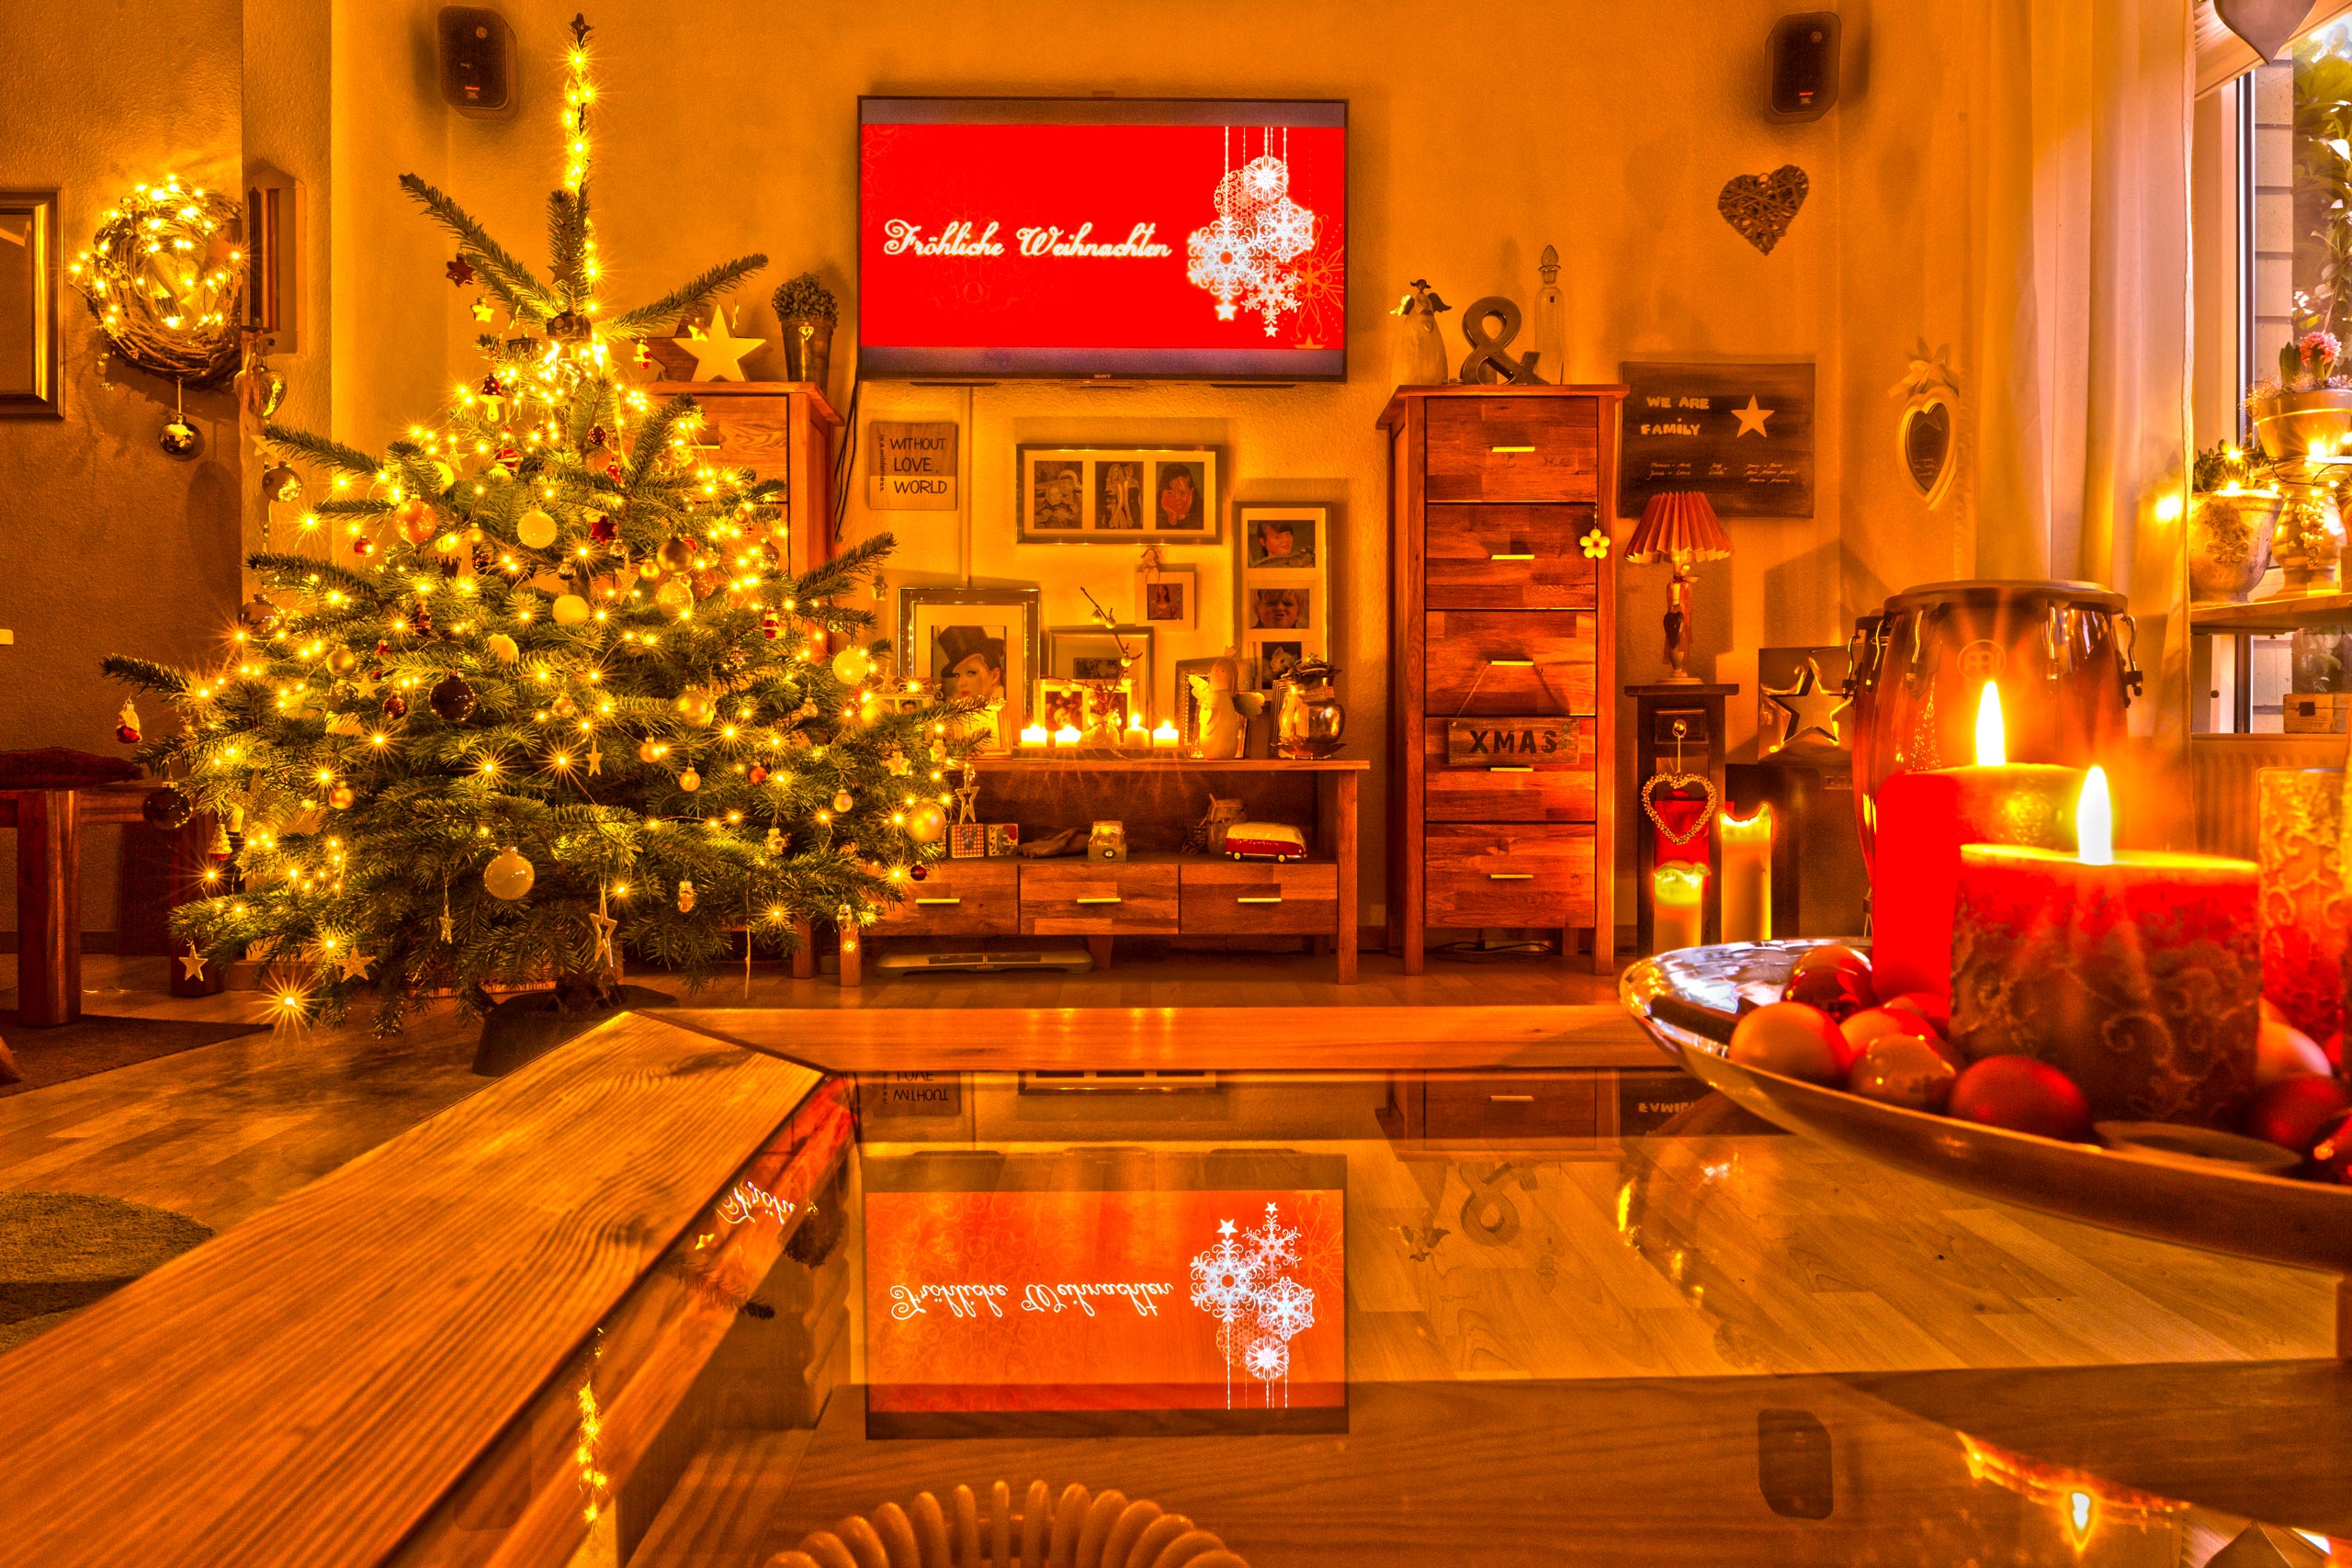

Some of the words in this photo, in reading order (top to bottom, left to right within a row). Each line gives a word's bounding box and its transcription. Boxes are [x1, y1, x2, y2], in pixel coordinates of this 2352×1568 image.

[884, 219, 1005, 256] Fröhliche
[1016, 221, 1172, 257] Weihnachten
[1459, 296, 1551, 385] &
[1646, 396, 1672, 409] WE
[1679, 396, 1710, 410] ARE
[889, 437, 946, 451] WITHOUT
[894, 479, 947, 494] WORLD
[1470, 730, 1557, 753] XMAS
